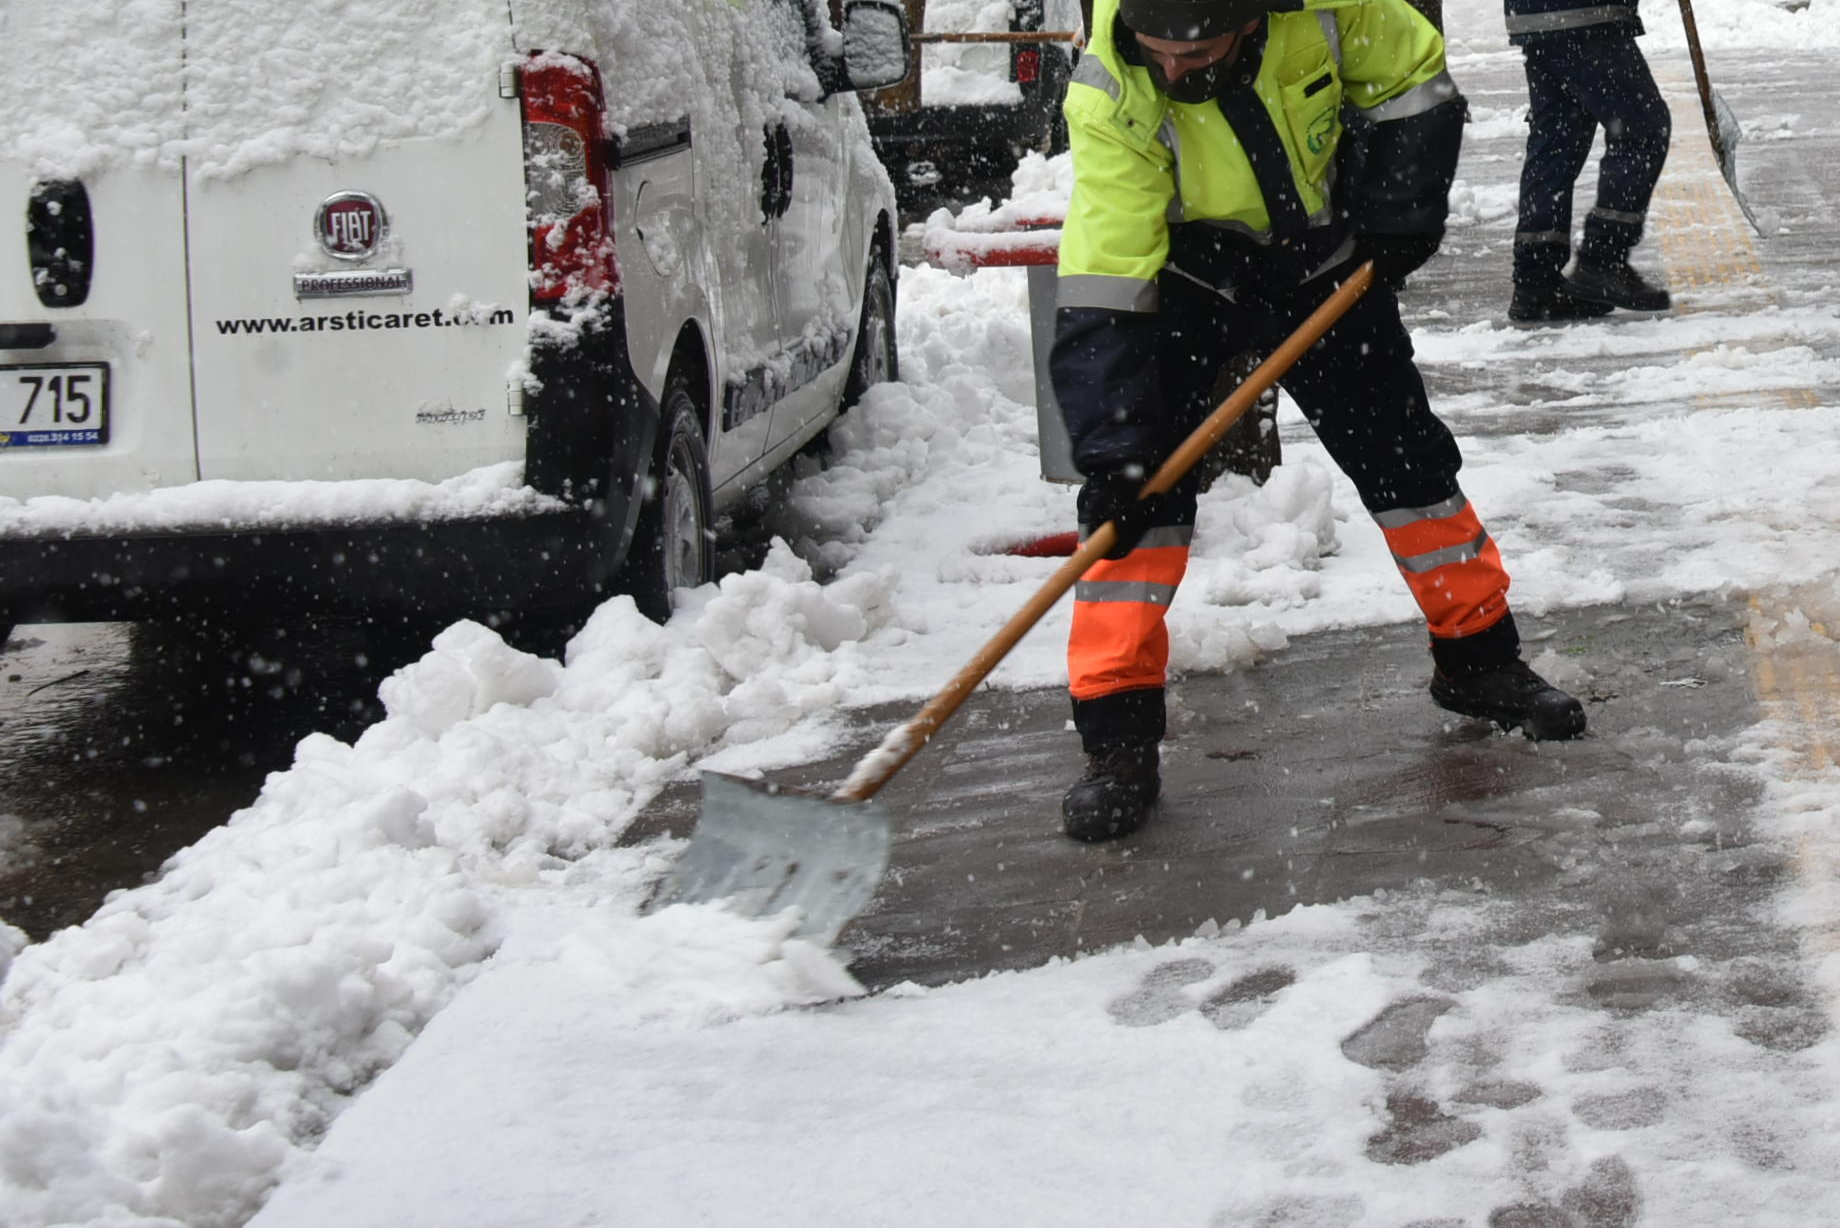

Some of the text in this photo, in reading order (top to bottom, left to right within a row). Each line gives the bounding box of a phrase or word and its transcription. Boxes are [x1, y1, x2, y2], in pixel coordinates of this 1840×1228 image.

[330, 210, 371, 243] FIAT
[301, 275, 402, 291] PROFESSIONAL
[216, 307, 514, 335] www.arsticaret.cm
[18, 375, 91, 424] 715
